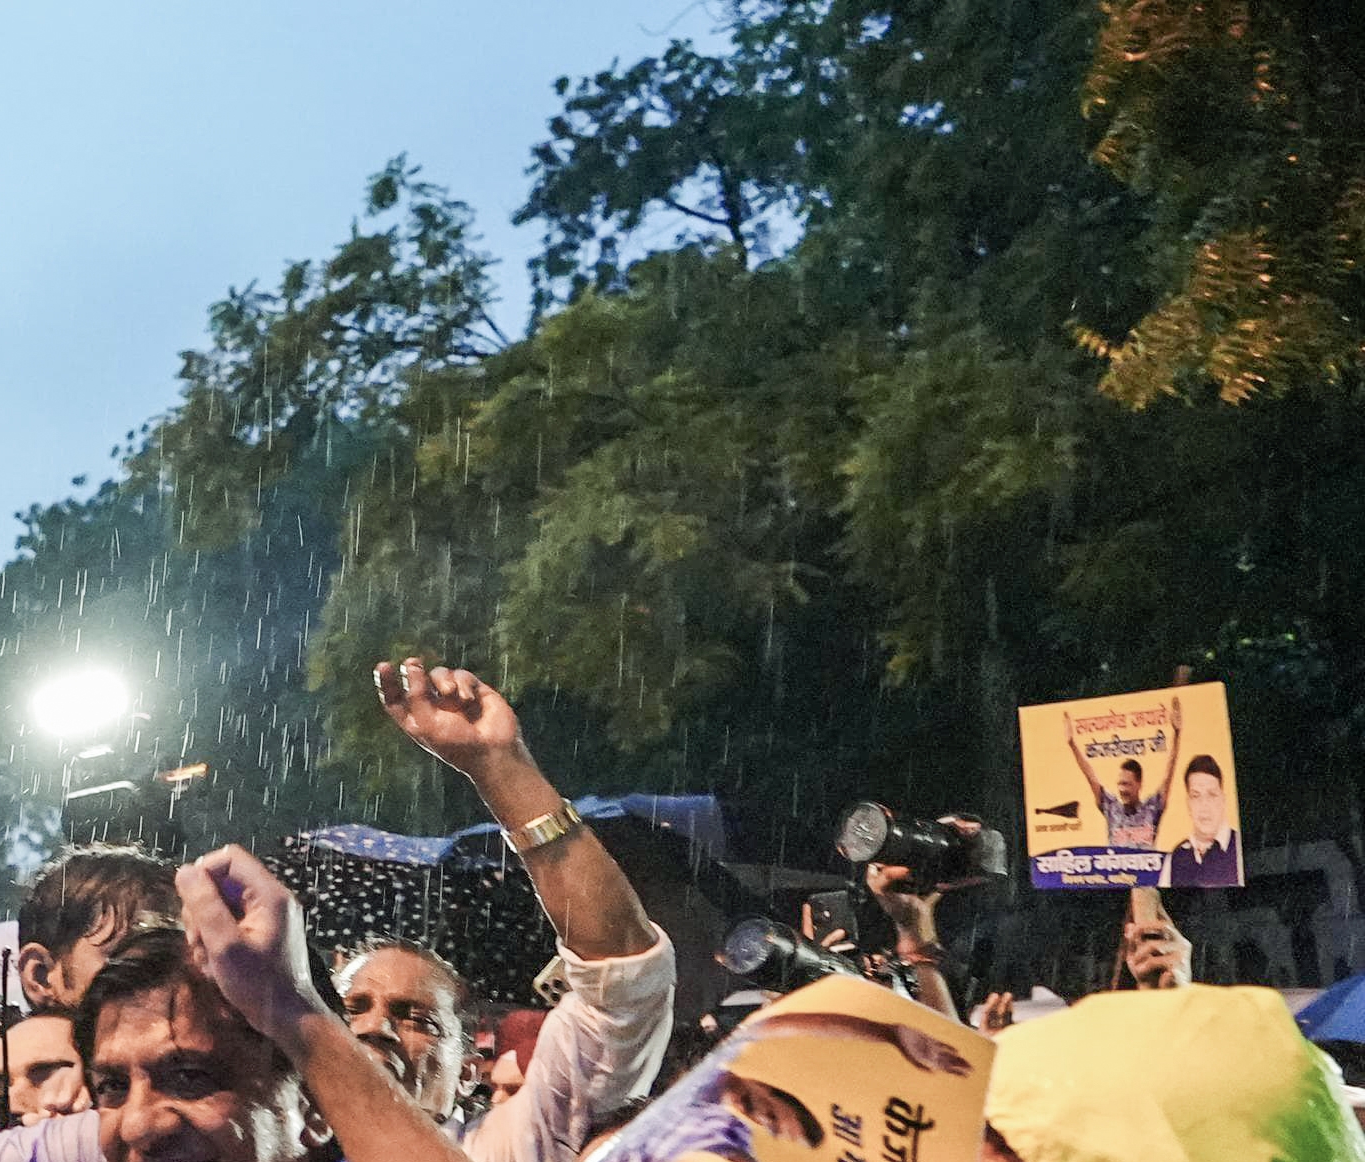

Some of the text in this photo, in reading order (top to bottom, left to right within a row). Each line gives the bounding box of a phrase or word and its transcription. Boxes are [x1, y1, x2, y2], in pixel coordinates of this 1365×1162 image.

[1075, 708, 1127, 735] सत्यमेव
[1085, 728, 1168, 759] केजरीवाल जी
[831, 1103, 862, 1147] आ
